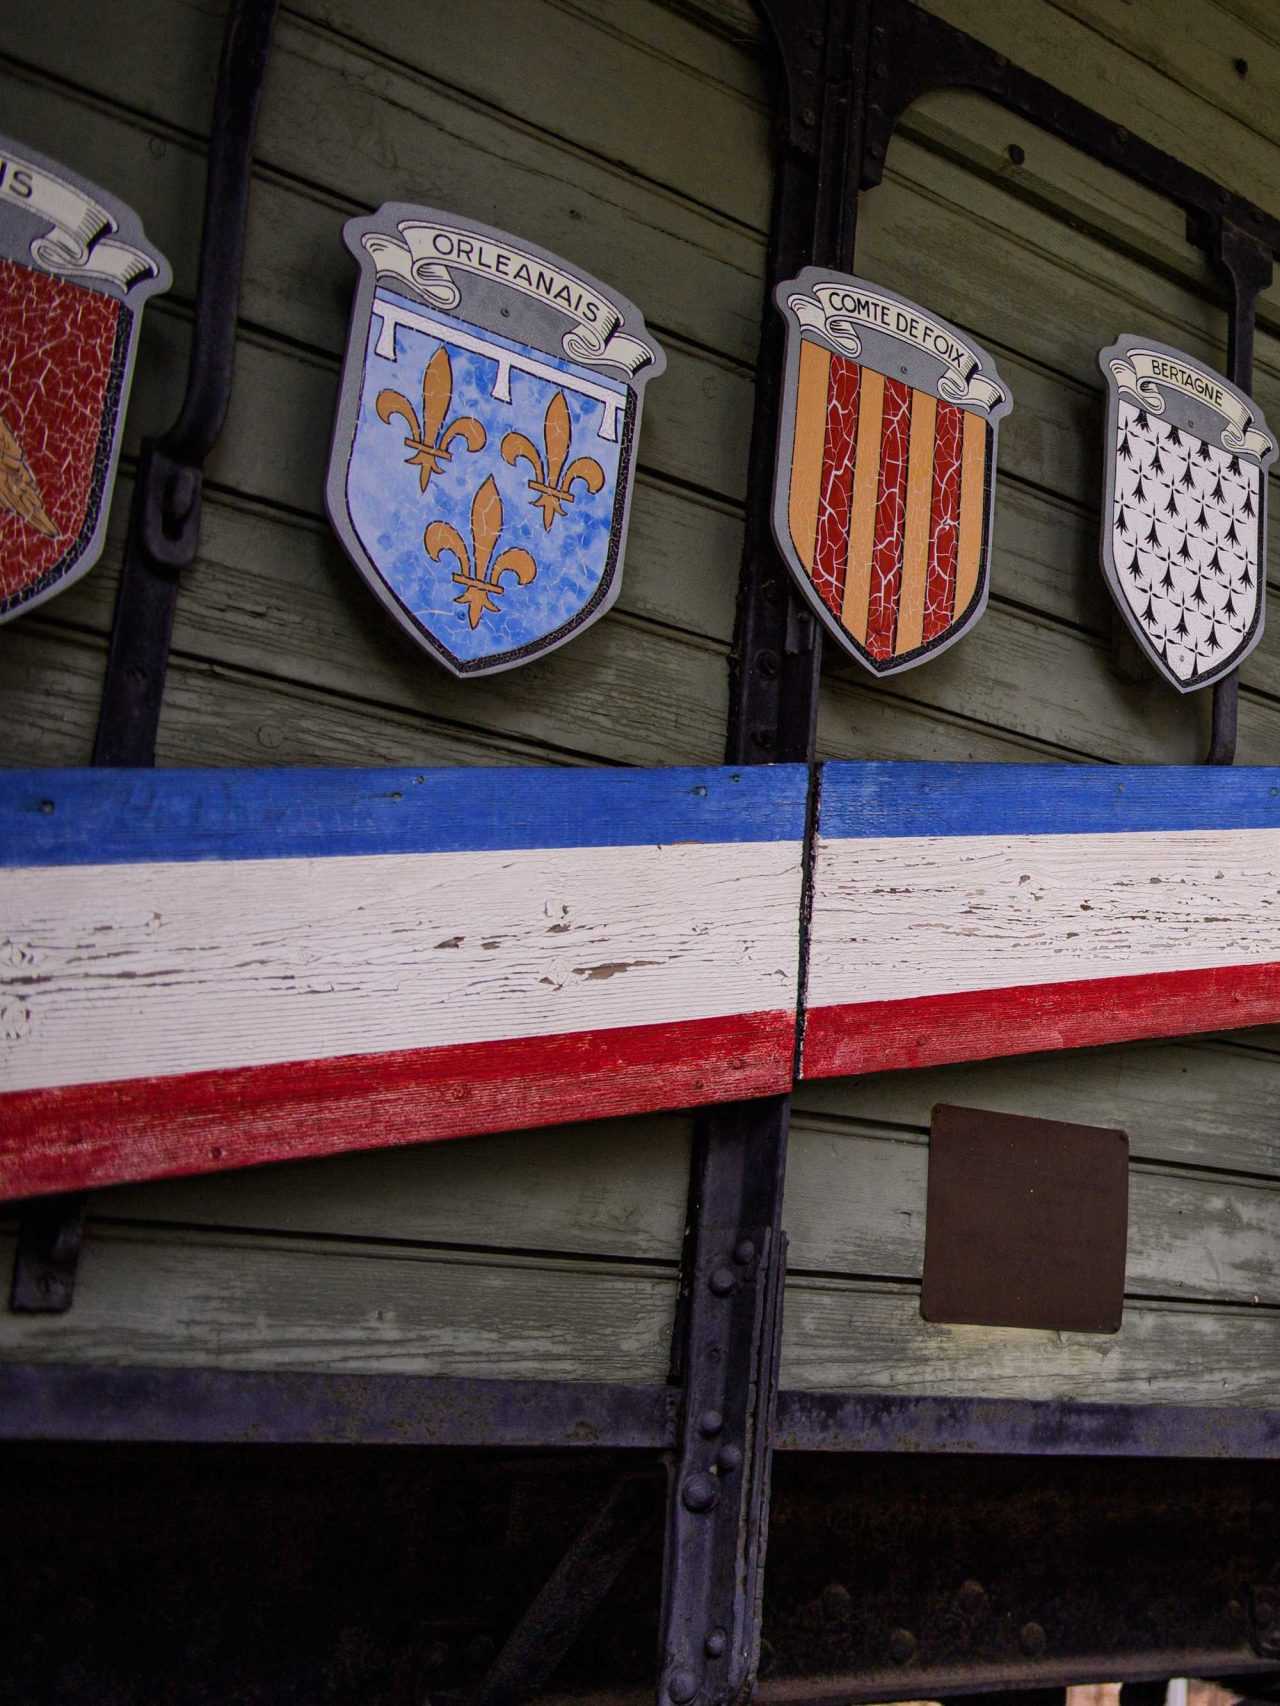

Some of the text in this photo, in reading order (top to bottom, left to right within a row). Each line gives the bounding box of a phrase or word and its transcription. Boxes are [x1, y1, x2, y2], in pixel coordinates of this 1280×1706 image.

[432, 233, 600, 322] ORLEANAIS
[829, 291, 965, 368] COMTE DE FOIX
[1151, 359, 1224, 407] BERTAGNE
